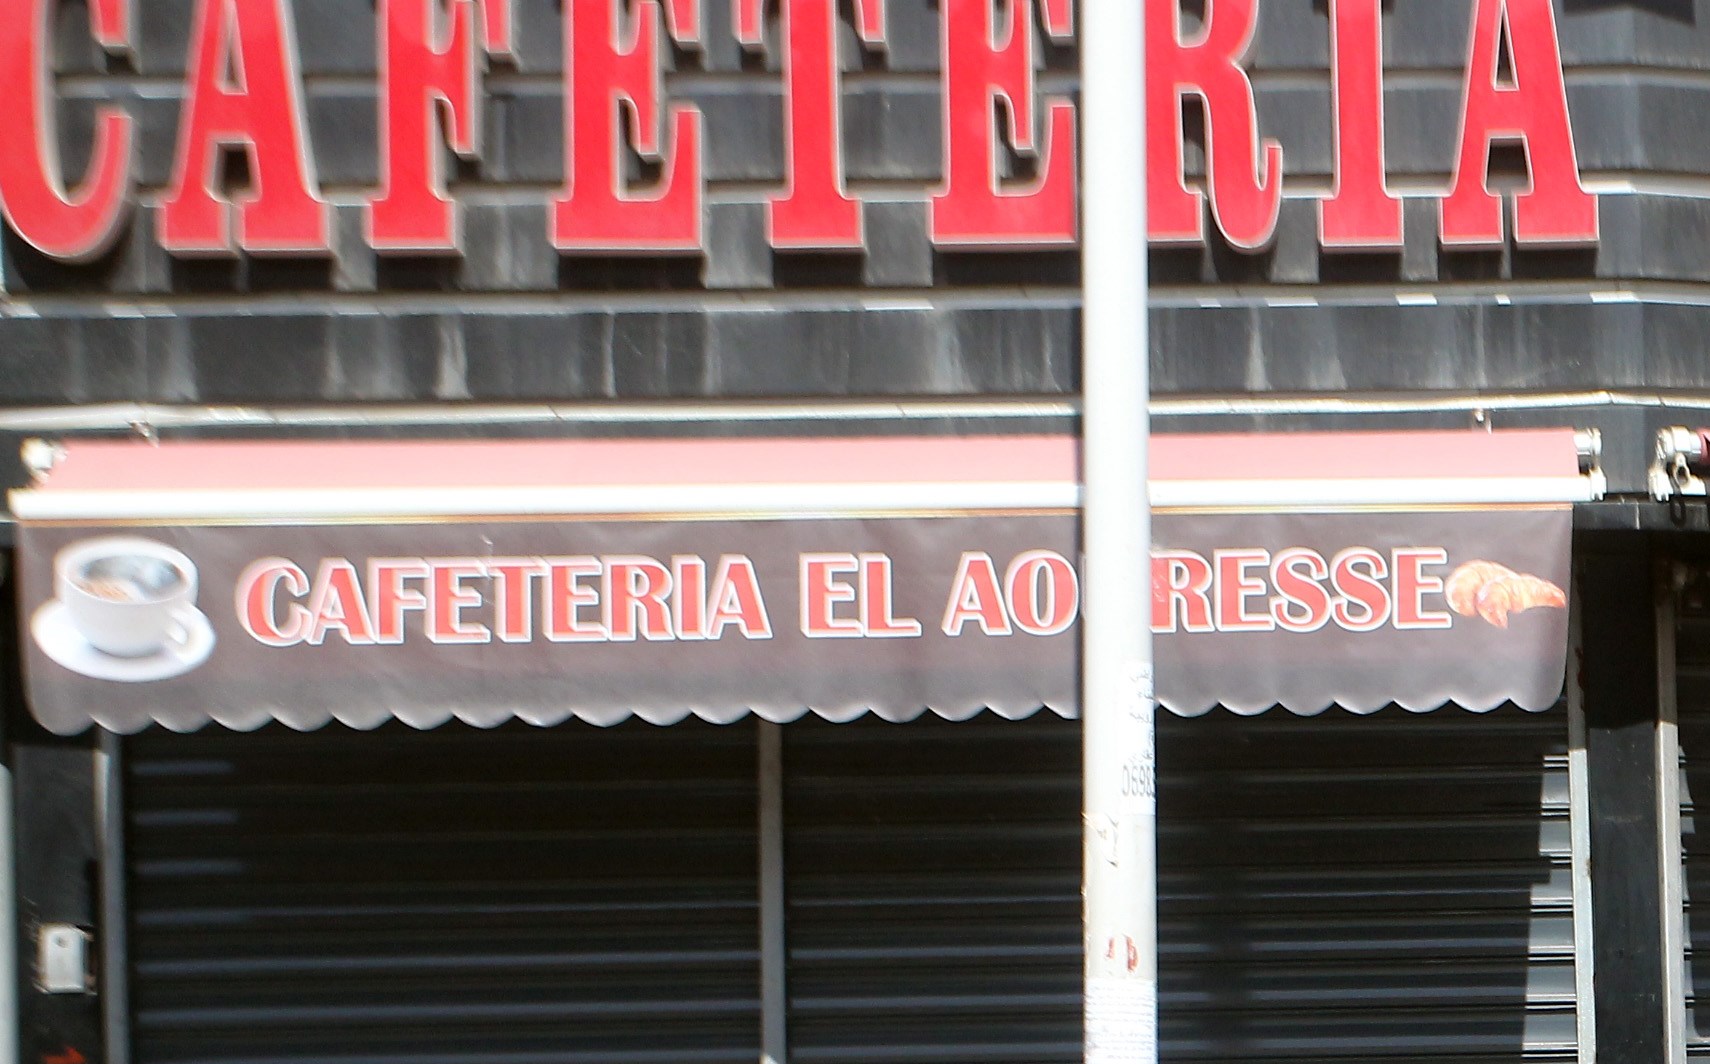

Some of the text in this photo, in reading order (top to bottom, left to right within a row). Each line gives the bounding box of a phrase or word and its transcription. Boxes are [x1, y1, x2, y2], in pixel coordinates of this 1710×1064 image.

[0, 0, 1602, 260] CAFETERIA
[234, 545, 1454, 648] CAFETERIA EL AORESSE
